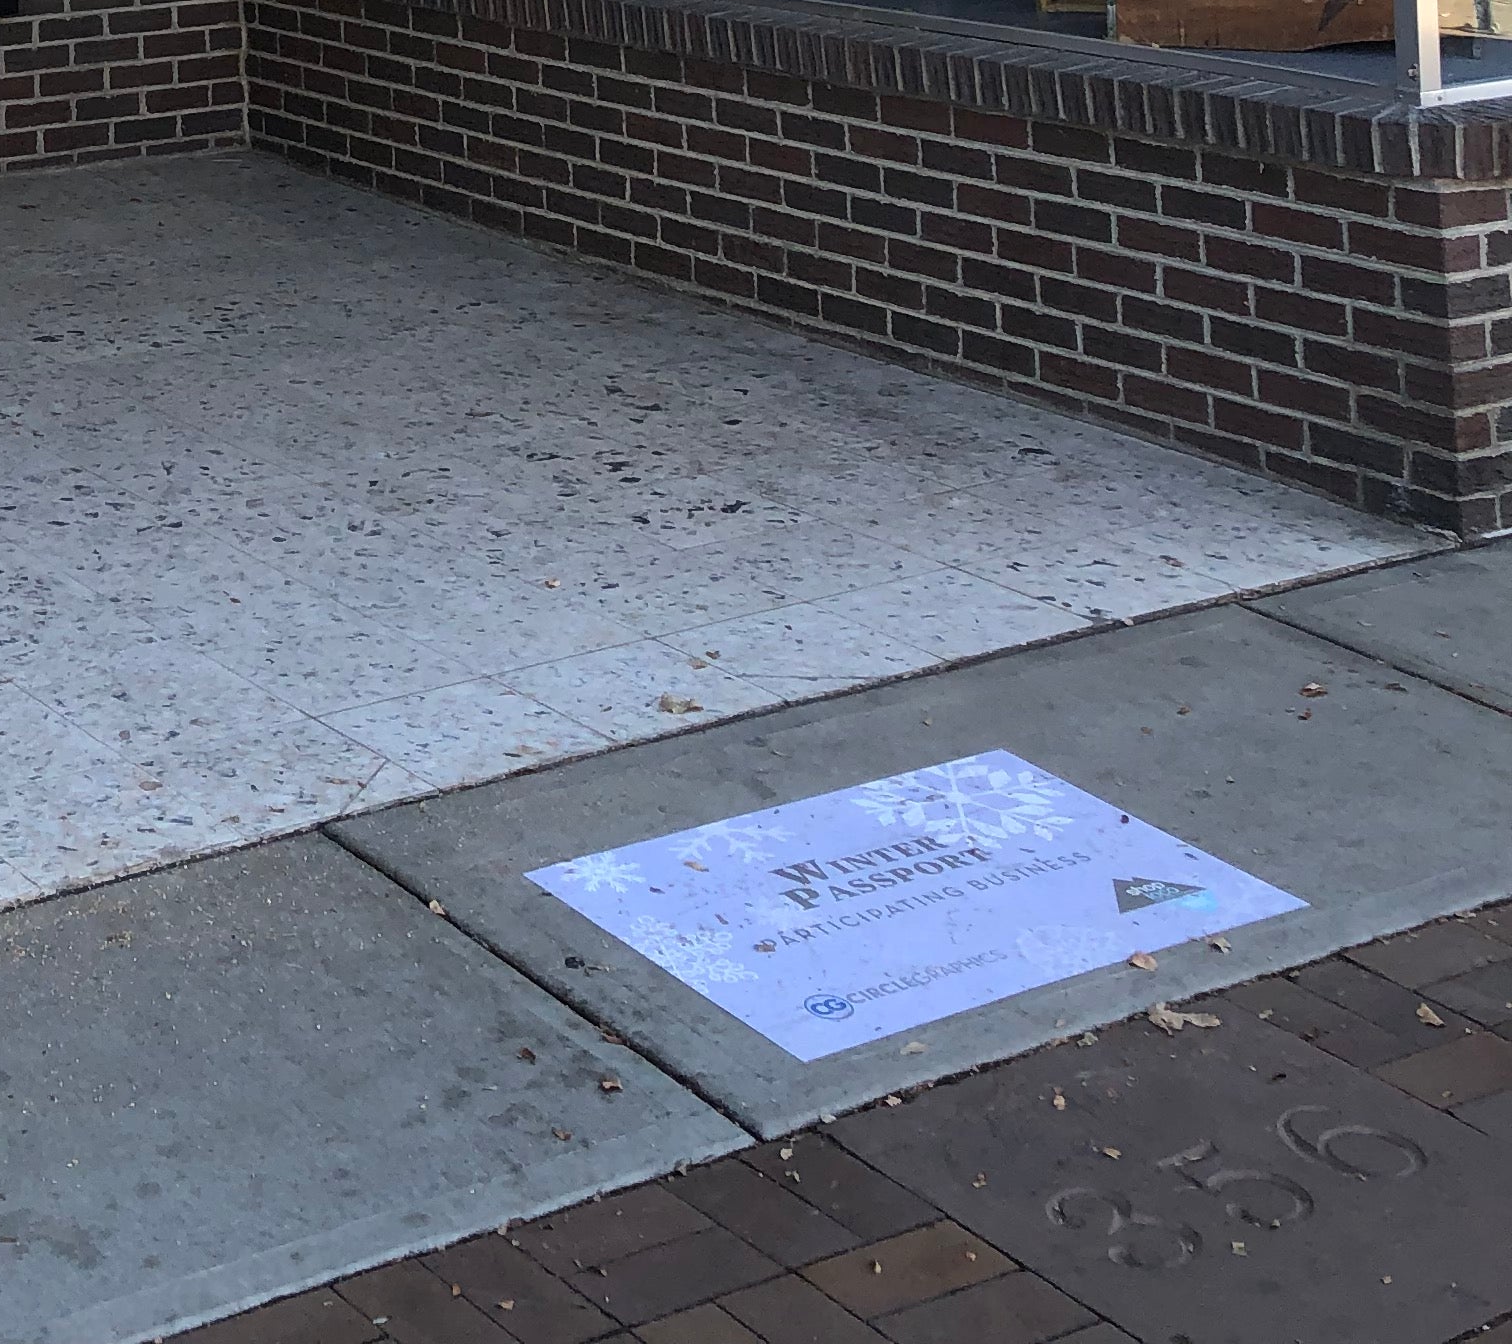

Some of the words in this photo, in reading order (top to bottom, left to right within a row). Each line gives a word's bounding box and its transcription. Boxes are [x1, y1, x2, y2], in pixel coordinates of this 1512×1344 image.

[758, 885, 966, 952] PARTICIPATING
[966, 850, 1092, 892] BUSINESS
[769, 835, 950, 887] WINTER
[778, 846, 992, 911] PASSPORT
[1044, 1105, 1429, 1269] 356
